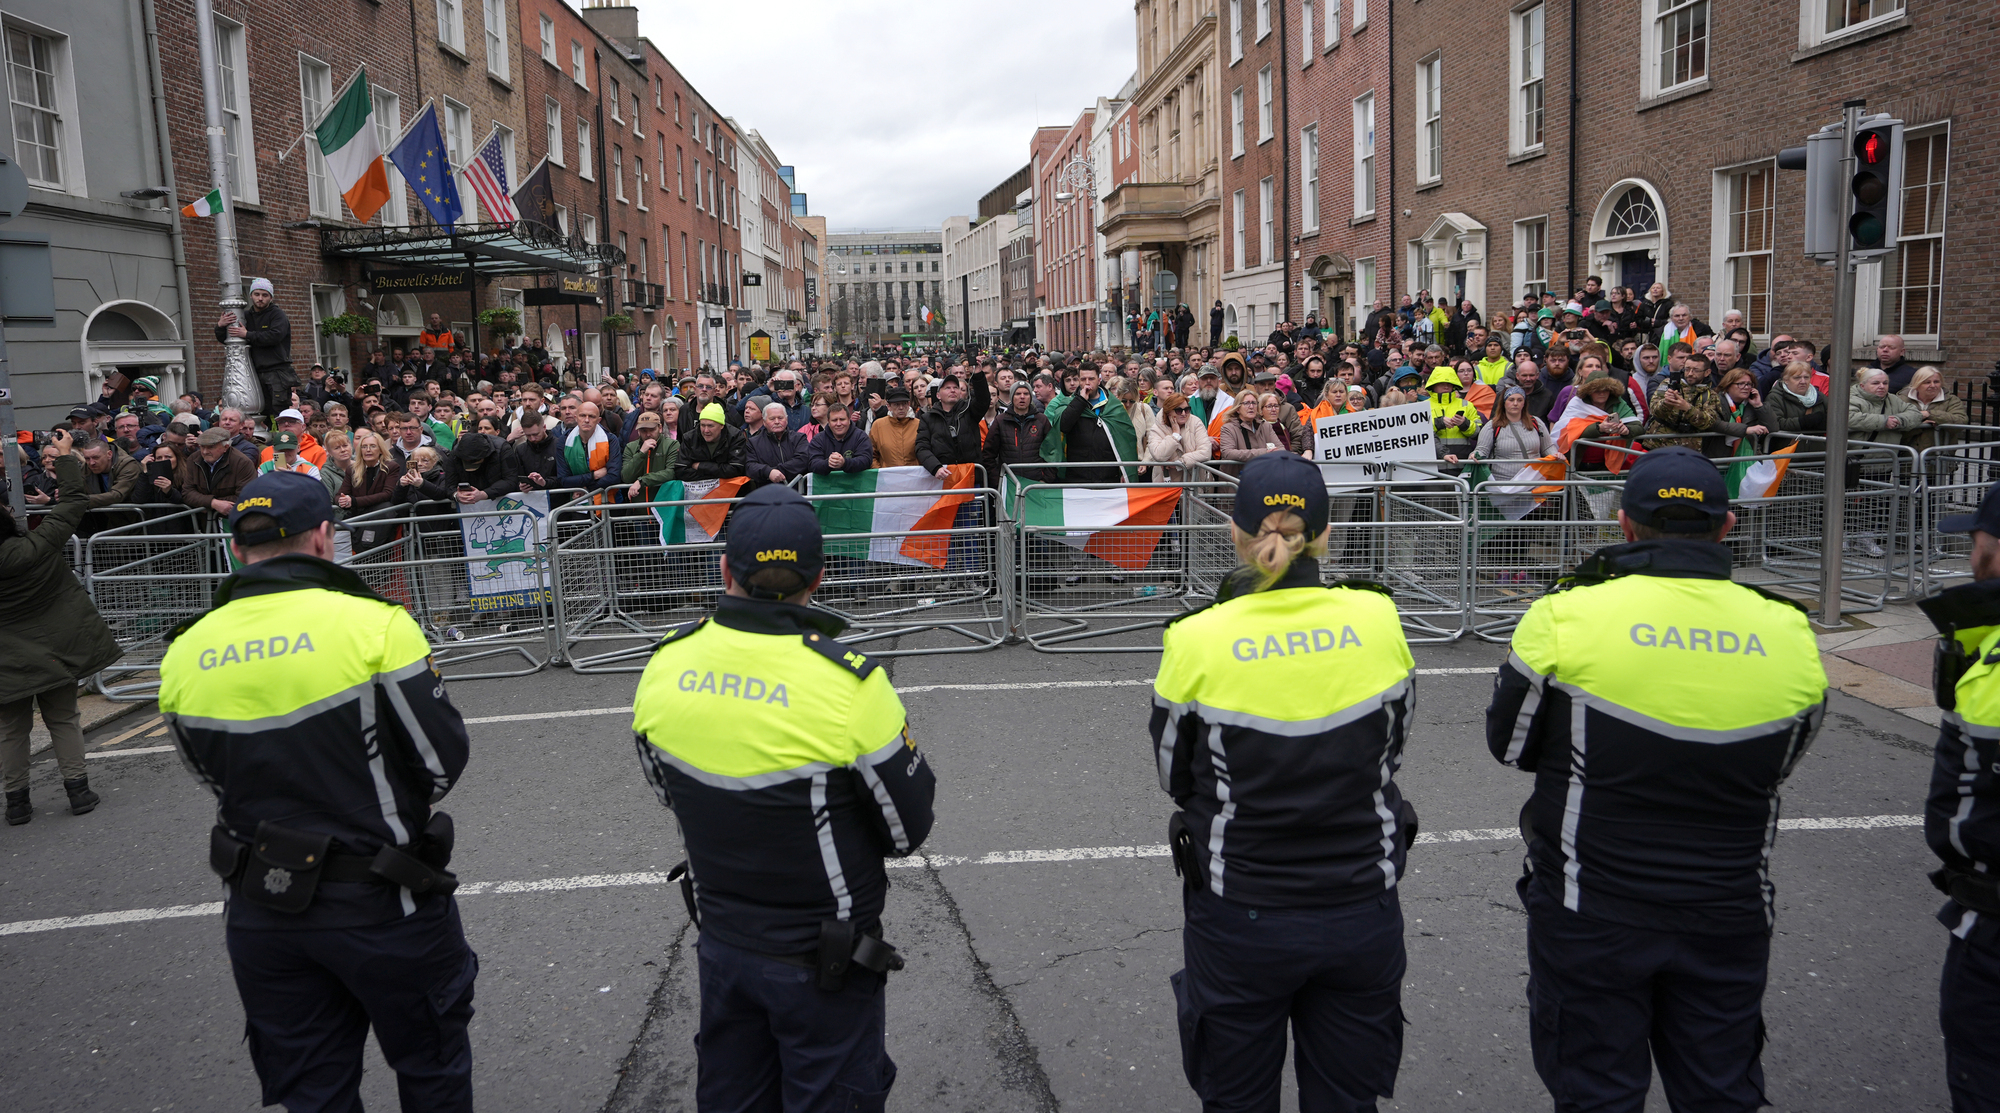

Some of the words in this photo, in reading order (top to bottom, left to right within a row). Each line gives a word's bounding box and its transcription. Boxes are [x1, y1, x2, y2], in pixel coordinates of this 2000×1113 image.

[375, 273, 429, 288] Buswells
[431, 271, 465, 286] Hotel
[1320, 414, 1407, 439] REFERENDUM
[1410, 411, 1428, 424] ON
[1324, 448, 1342, 460] EU
[1345, 433, 1429, 457] MEMBERSHIP
[236, 497, 273, 512] GARDA
[1263, 493, 1306, 510] GARDA
[1657, 487, 1704, 503] GARDA
[755, 549, 798, 563] GARDA
[470, 594, 524, 611] FIGHTING
[528, 590, 553, 605] IRS
[199, 632, 315, 671] GARDA
[1232, 625, 1363, 662] GARDA
[1629, 623, 1767, 657] GARDA
[678, 669, 789, 708] GARDA
